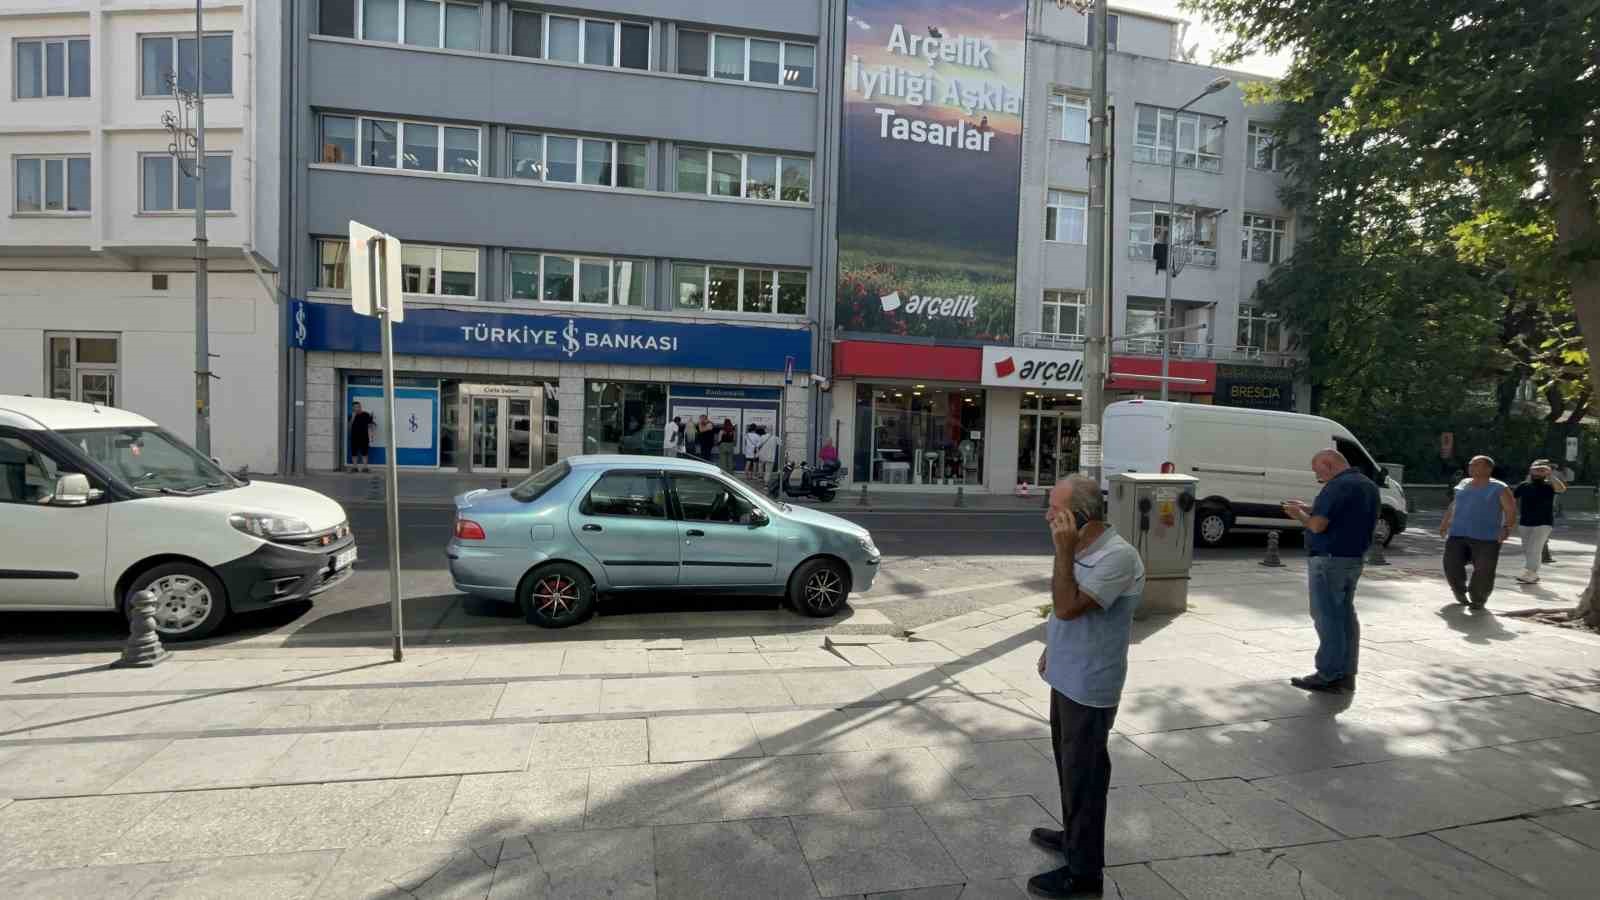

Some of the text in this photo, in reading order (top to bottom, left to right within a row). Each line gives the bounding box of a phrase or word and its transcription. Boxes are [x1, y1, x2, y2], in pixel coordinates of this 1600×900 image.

[887, 23, 992, 69] Arçelik
[851, 54, 1021, 117] İyiliği Aşkla
[874, 107, 995, 152] Tasarlar
[905, 294, 978, 320] arçelik
[460, 323, 557, 345] TÜRKİYE
[585, 332, 678, 351] BANKASI
[1019, 358, 1084, 386] arçeli
